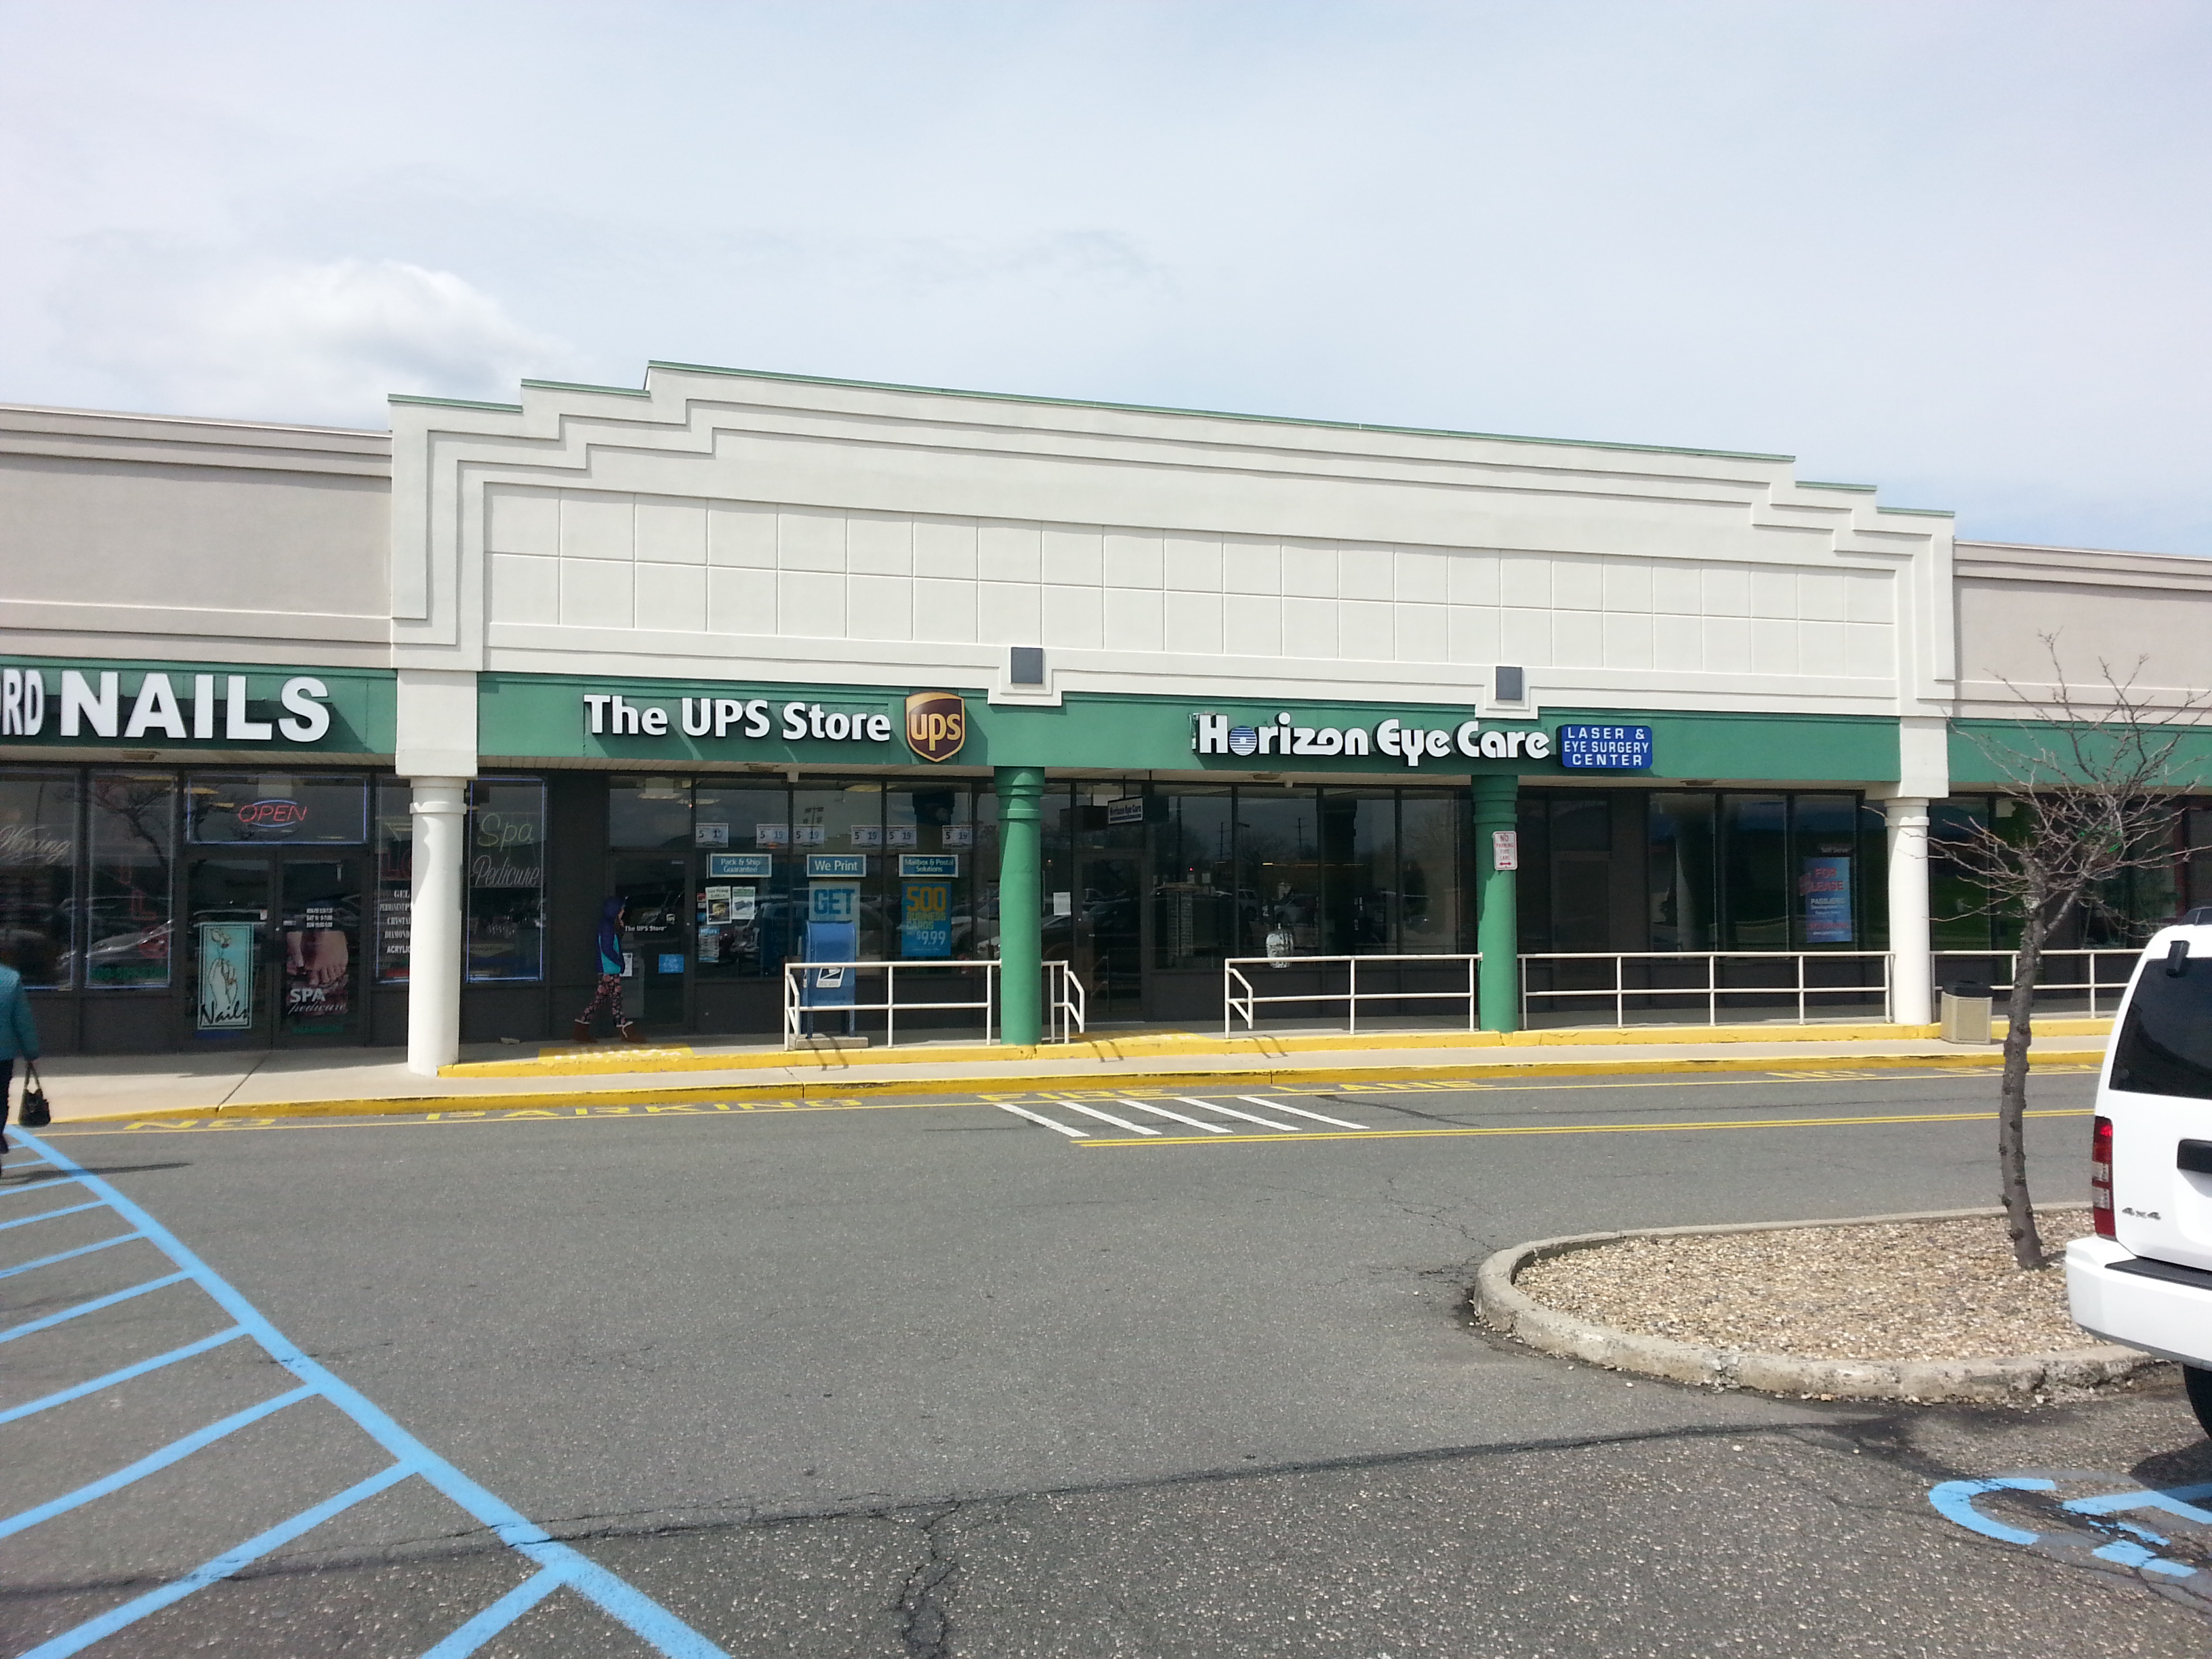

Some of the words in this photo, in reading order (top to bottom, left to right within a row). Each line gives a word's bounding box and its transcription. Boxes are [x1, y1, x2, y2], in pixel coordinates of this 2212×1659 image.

[60, 670, 330, 743] NAILS
[583, 694, 668, 735] The
[681, 697, 770, 738] UPS
[781, 701, 891, 741] Store
[910, 714, 960, 751] ups
[1567, 726, 1624, 739] LASER
[1635, 729, 1645, 740] &
[1376, 718, 1451, 766] Eye
[1457, 720, 1551, 759] Care
[1564, 741, 1587, 753] EYE
[1591, 741, 1650, 754] SURGERY
[1572, 754, 1643, 766] CENTER
[239, 804, 308, 823] OPEN
[477, 813, 535, 853] Spa
[746, 858, 761, 867] Ship
[815, 860, 831, 871] We
[834, 861, 858, 871] Print
[935, 858, 954, 866] Postal
[472, 855, 541, 887] Pedicure
[1814, 867, 1837, 878] FOR
[1811, 880, 1844, 892] LEASE
[814, 888, 855, 915] GET
[907, 886, 947, 912] 500
[289, 987, 326, 1003] SPA
[201, 1001, 249, 1024] Nails
[1269, 1080, 1495, 1093] LANE
[977, 1088, 1181, 1102] FIRE
[426, 1099, 862, 1121] PARKING
[123, 1119, 276, 1130] NO
